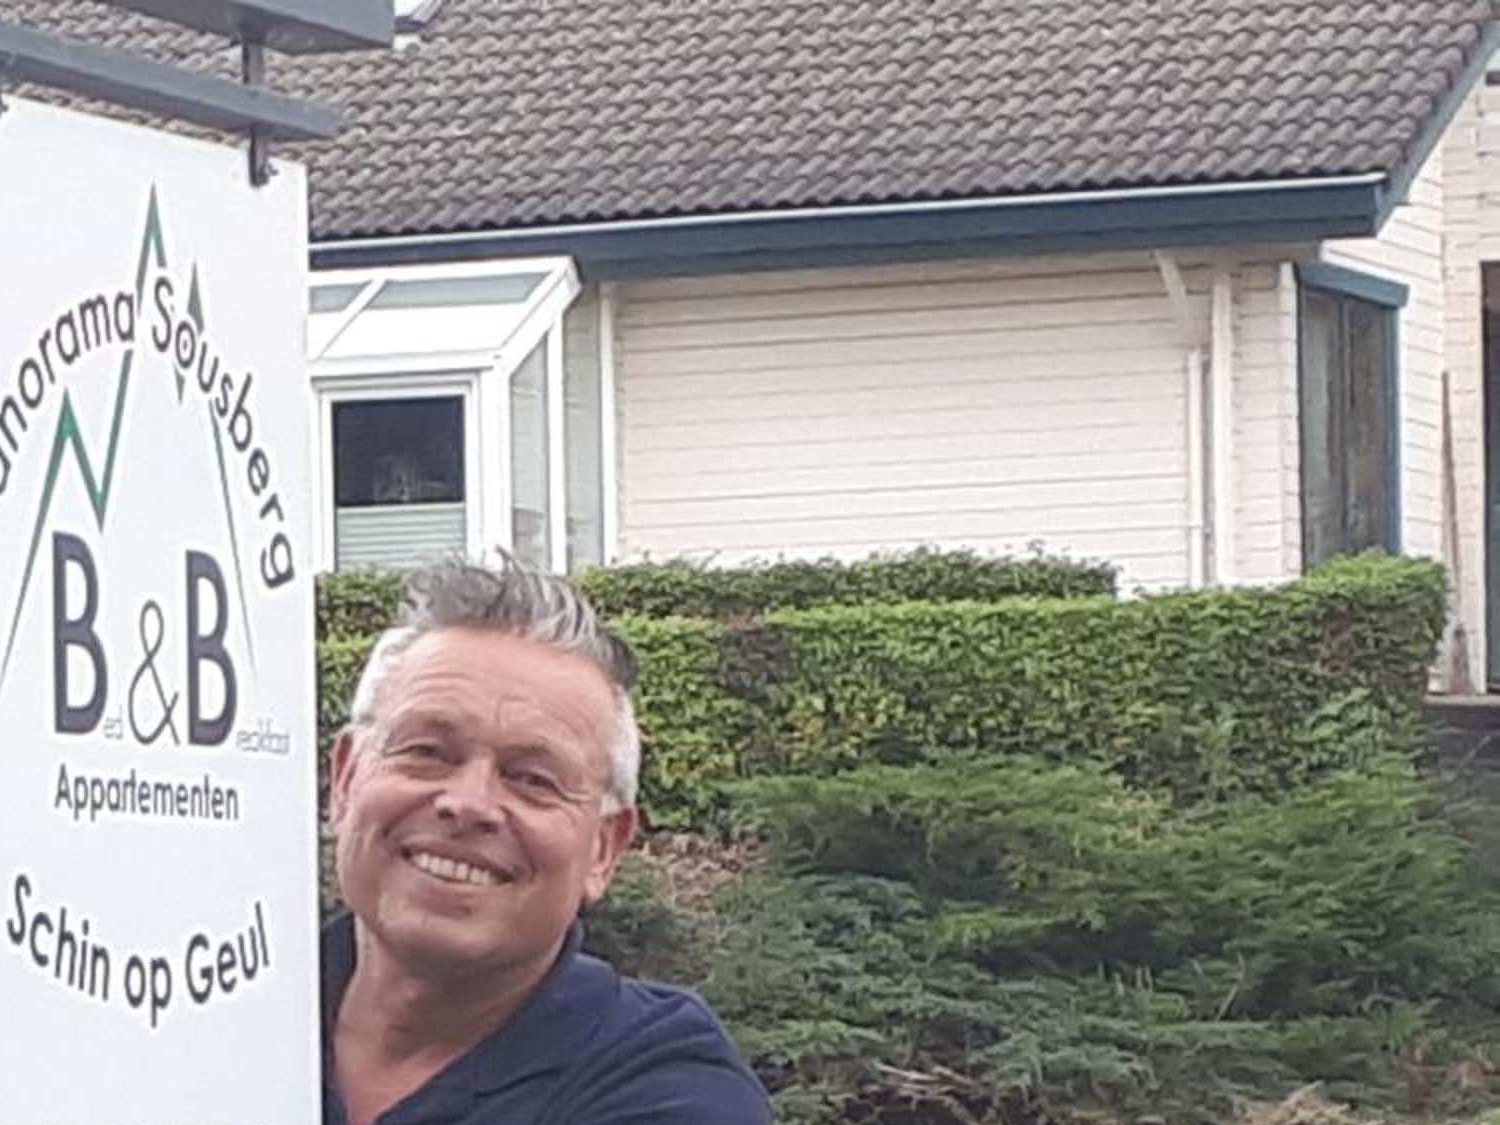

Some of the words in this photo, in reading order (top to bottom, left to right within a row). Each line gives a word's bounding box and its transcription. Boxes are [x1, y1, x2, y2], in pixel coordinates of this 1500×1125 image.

[151, 275, 295, 590] Sousberg
[52, 530, 238, 747] B&B
[53, 763, 239, 822] Appartementen
[7, 874, 111, 1001] Schin
[124, 955, 172, 1028] op
[185, 901, 270, 1004] Geul
